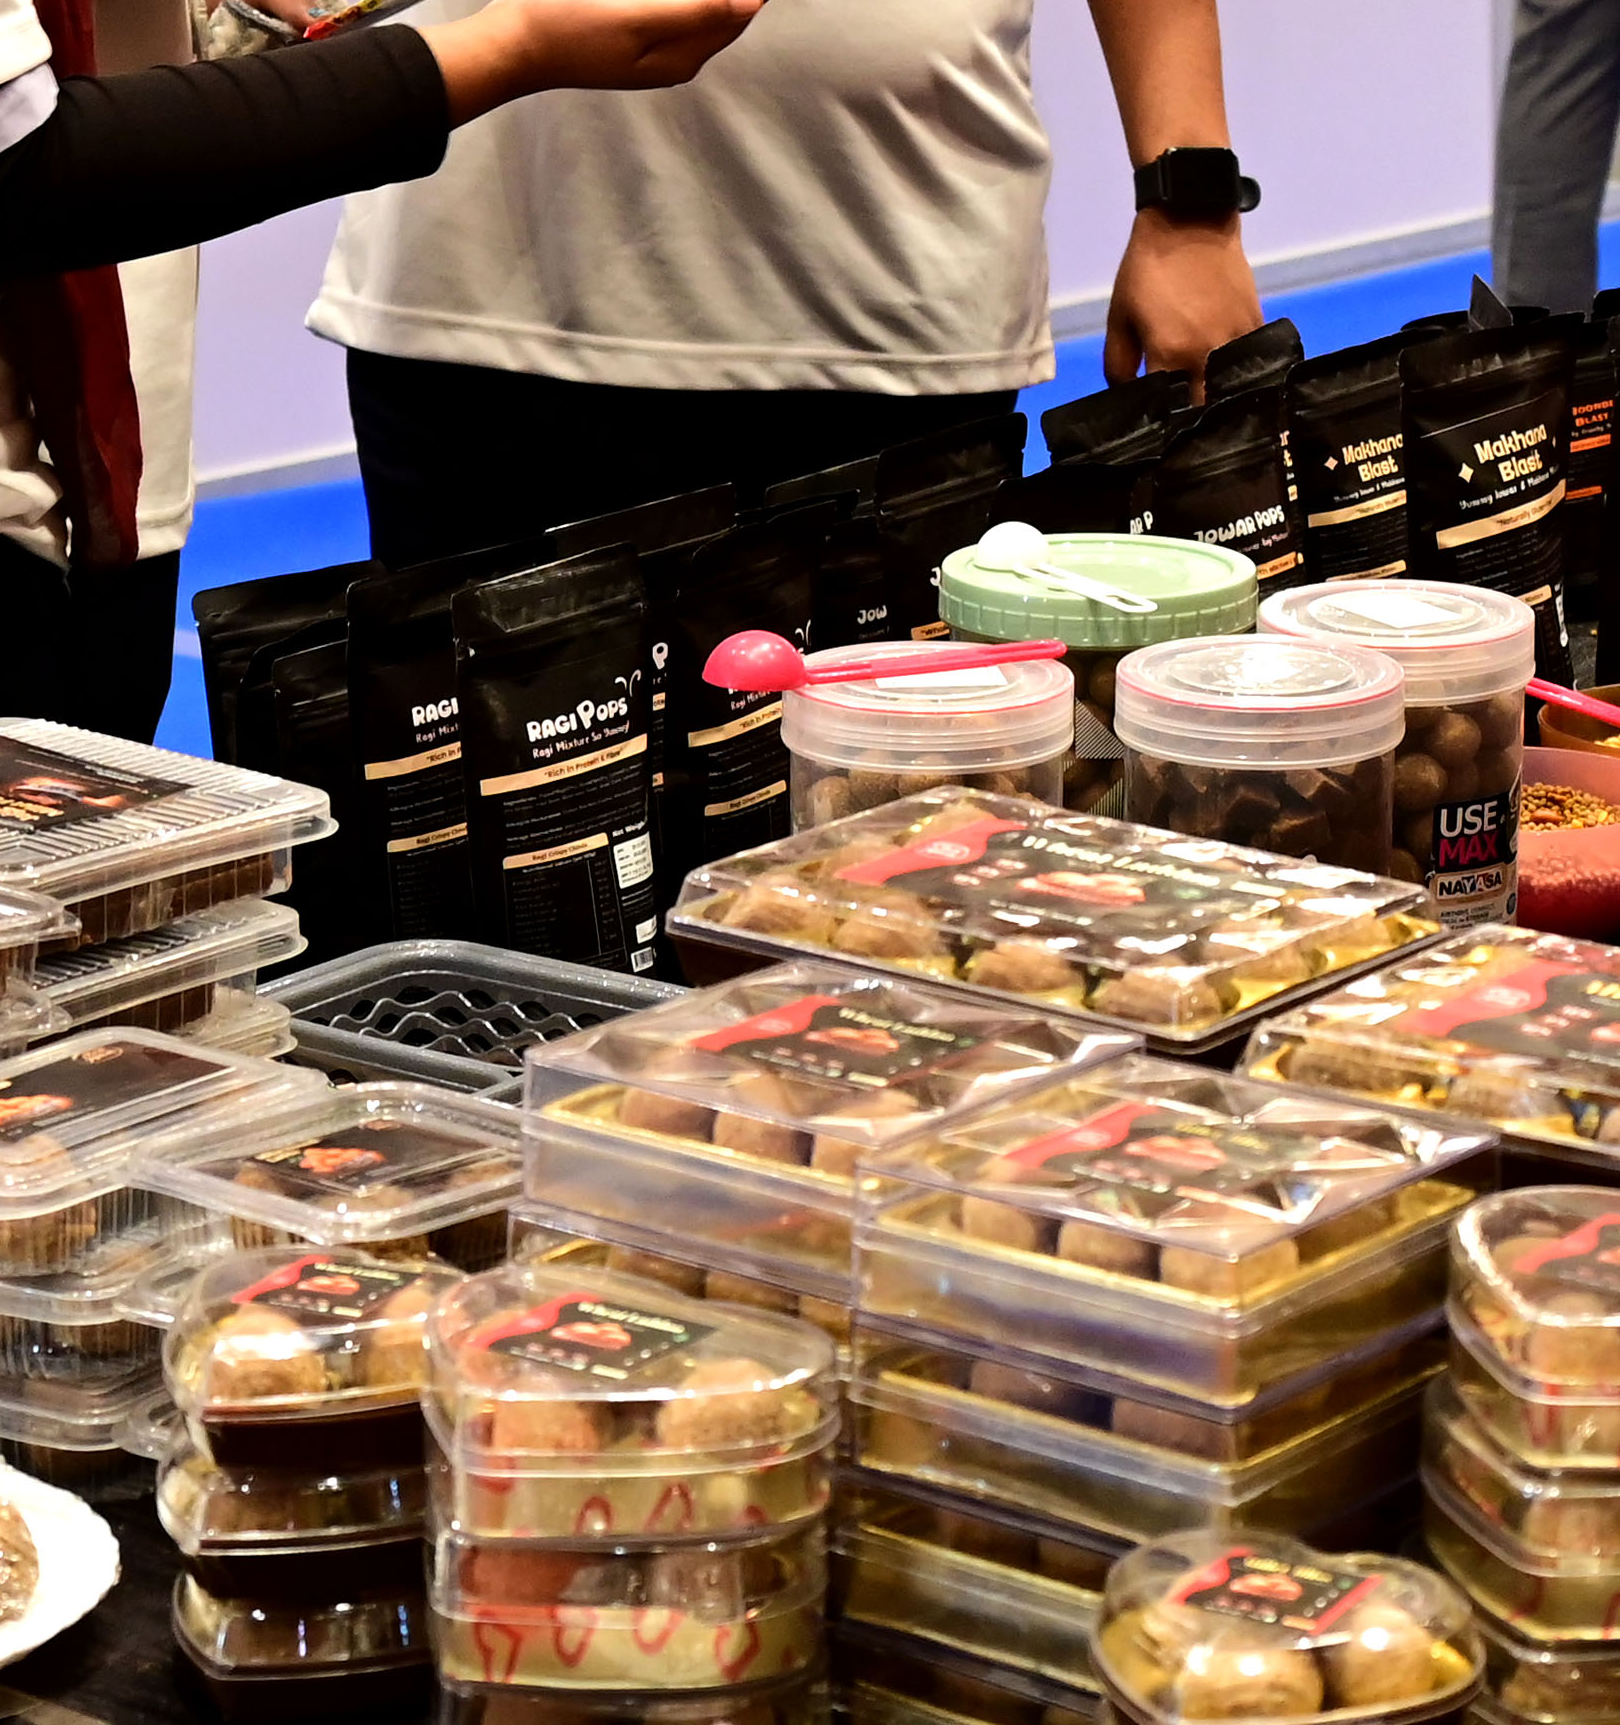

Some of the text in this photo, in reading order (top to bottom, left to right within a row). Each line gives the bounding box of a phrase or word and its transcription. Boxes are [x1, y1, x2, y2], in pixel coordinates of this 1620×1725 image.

[1473, 423, 1548, 465] Makhana
[1357, 454, 1399, 483] Blast
[1497, 449, 1543, 483] Blast
[1254, 505, 1285, 530] POPS
[412, 697, 459, 727] RAGI
[526, 713, 577, 743] RAGI
[532, 744, 554, 759] Ragi
[555, 736, 590, 753] Mixture
[1439, 800, 1498, 838] USE
[1438, 831, 1499, 867] MAX
[1438, 871, 1502, 896] NAYASA
